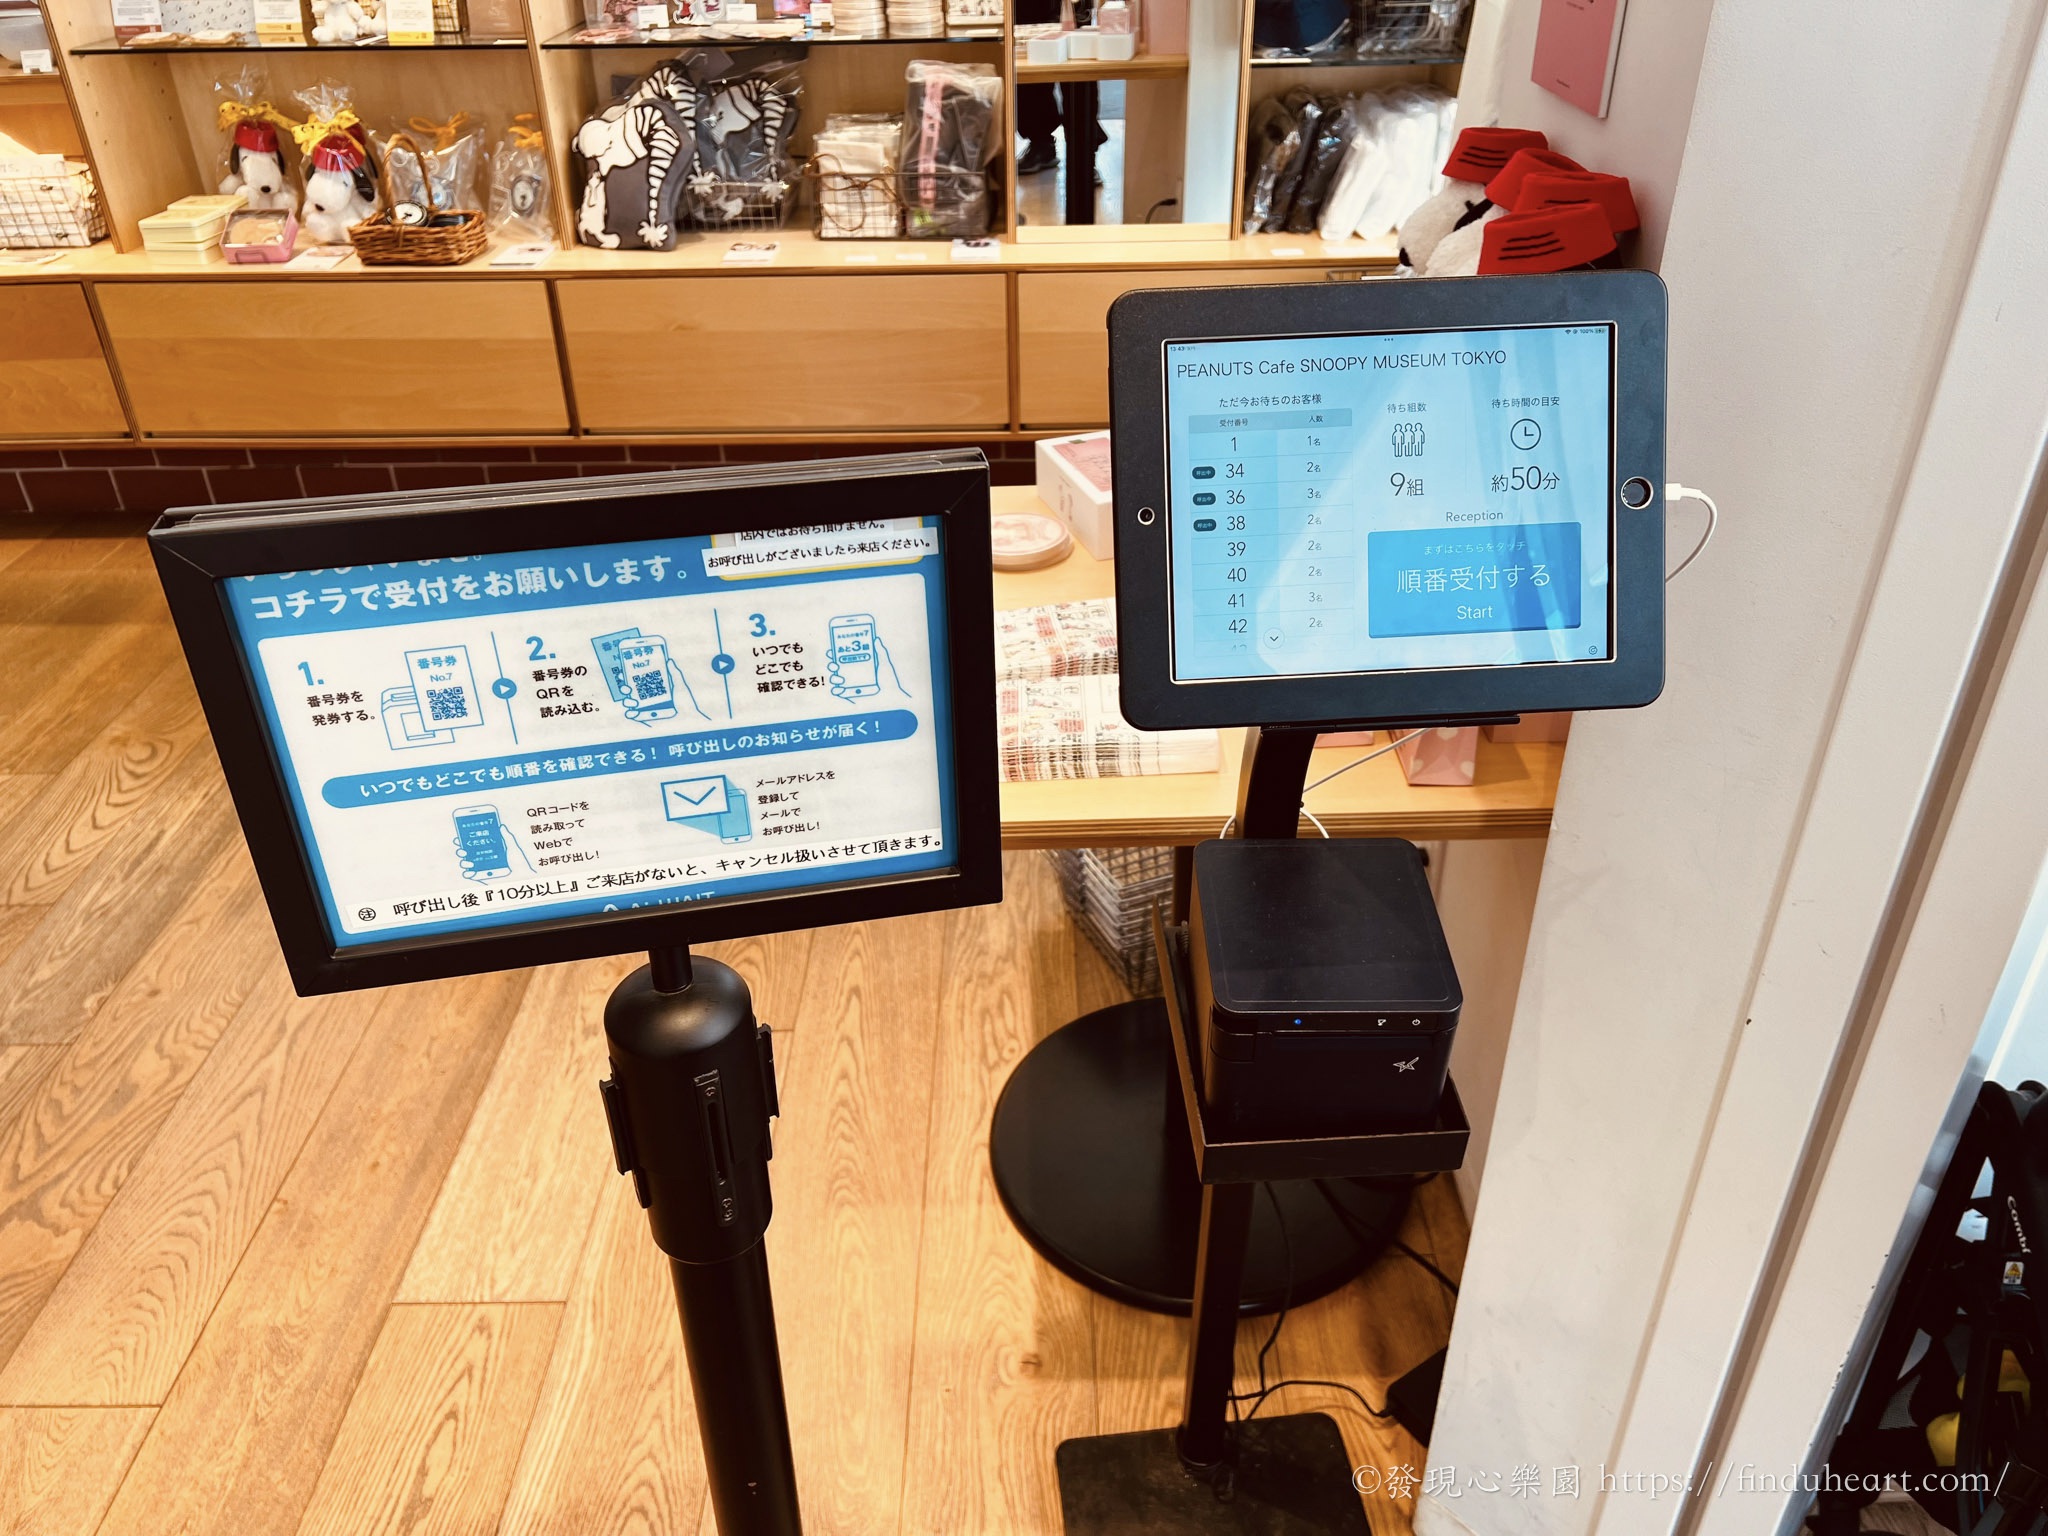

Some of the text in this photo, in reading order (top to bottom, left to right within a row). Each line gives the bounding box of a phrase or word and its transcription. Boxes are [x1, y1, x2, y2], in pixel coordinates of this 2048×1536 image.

[1177, 350, 1507, 378] PEANUTS Cafe SNOOPY MUSEUM TOKYO
[1219, 393, 1322, 408] ただ今お待ちのお客様
[1387, 402, 1427, 413] 待ち組数
[1491, 396, 1560, 409] 待ち時間の目安
[1219, 414, 1324, 428] 受付番号 人数
[1231, 435, 1321, 452] 1 1名
[1225, 463, 1245, 479] 34
[1307, 462, 1322, 473] 2名
[1491, 465, 1561, 493] 約50分
[1389, 472, 1425, 497] 9組
[1226, 489, 1246, 505] 36
[1307, 488, 1322, 499] 3名
[1226, 515, 1246, 531] 38
[1307, 514, 1322, 525] 2名
[1446, 510, 1504, 523] Reception
[707, 537, 931, 569] お呼び出しがございましたら来店ください。
[1227, 540, 1322, 557] 39 2名
[1424, 541, 1526, 555] まずはこちらをタッチ
[1227, 566, 1323, 582] 40 2名
[1397, 564, 1551, 594] 順番受付する
[251, 554, 687, 620] コチラで受付をお願いします。
[1227, 592, 1323, 608] 41 3名
[1456, 604, 1494, 620] Start
[748, 613, 776, 637] 3.
[1228, 617, 1324, 634] 42 2名
[525, 636, 557, 661] 2.
[752, 642, 804, 658] いつでも
[417, 655, 458, 671] 番号券
[632, 659, 650, 669] No.7
[755, 660, 804, 675] どこでも
[297, 661, 325, 687] 1.
[430, 672, 454, 683] No.7
[532, 664, 588, 682] 番号券の
[536, 685, 575, 700] QRを
[757, 675, 826, 694] 確認できる!
[306, 689, 365, 709] 番号券を
[312, 709, 376, 727] 発券する。
[540, 701, 601, 719] 読み込む。
[755, 770, 836, 788] メールアドレスを
[757, 791, 800, 805] 登録して
[526, 800, 590, 818] QRコードを
[760, 807, 802, 820] メールで
[530, 817, 586, 835] 読み取って
[762, 821, 820, 837] お呼び出し!
[533, 836, 574, 851] Webで
[538, 850, 600, 867] お呼び出し!
